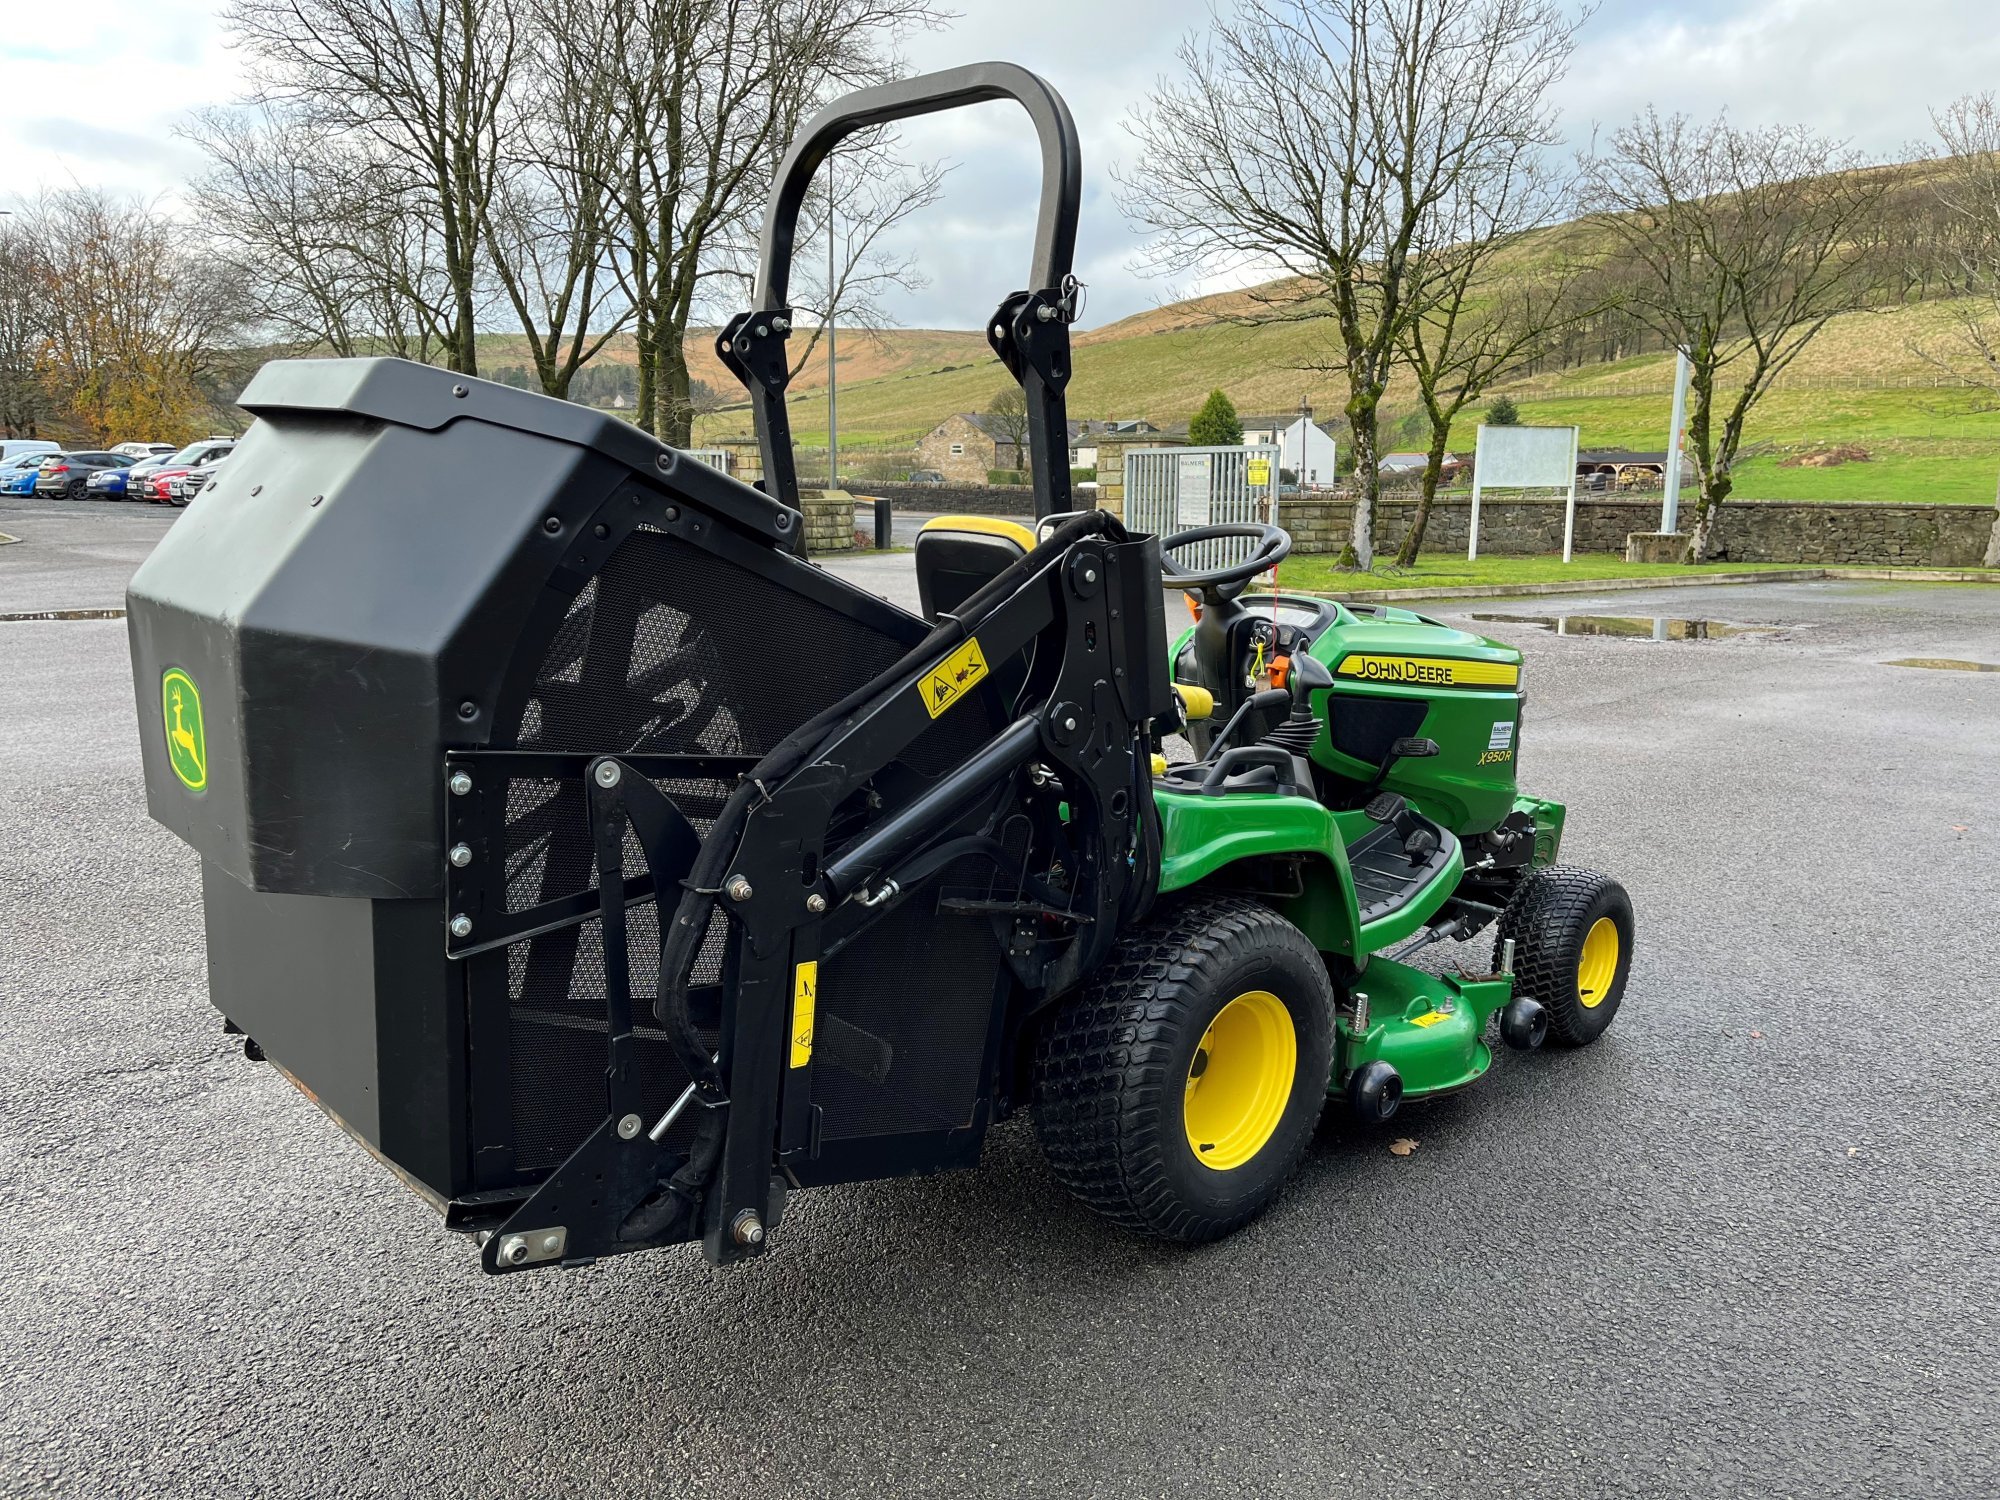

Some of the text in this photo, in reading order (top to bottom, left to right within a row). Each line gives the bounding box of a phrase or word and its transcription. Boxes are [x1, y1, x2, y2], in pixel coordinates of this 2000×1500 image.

[1356, 657, 1454, 683] JOHN DEERE
[1477, 750, 1513, 766] X950R
